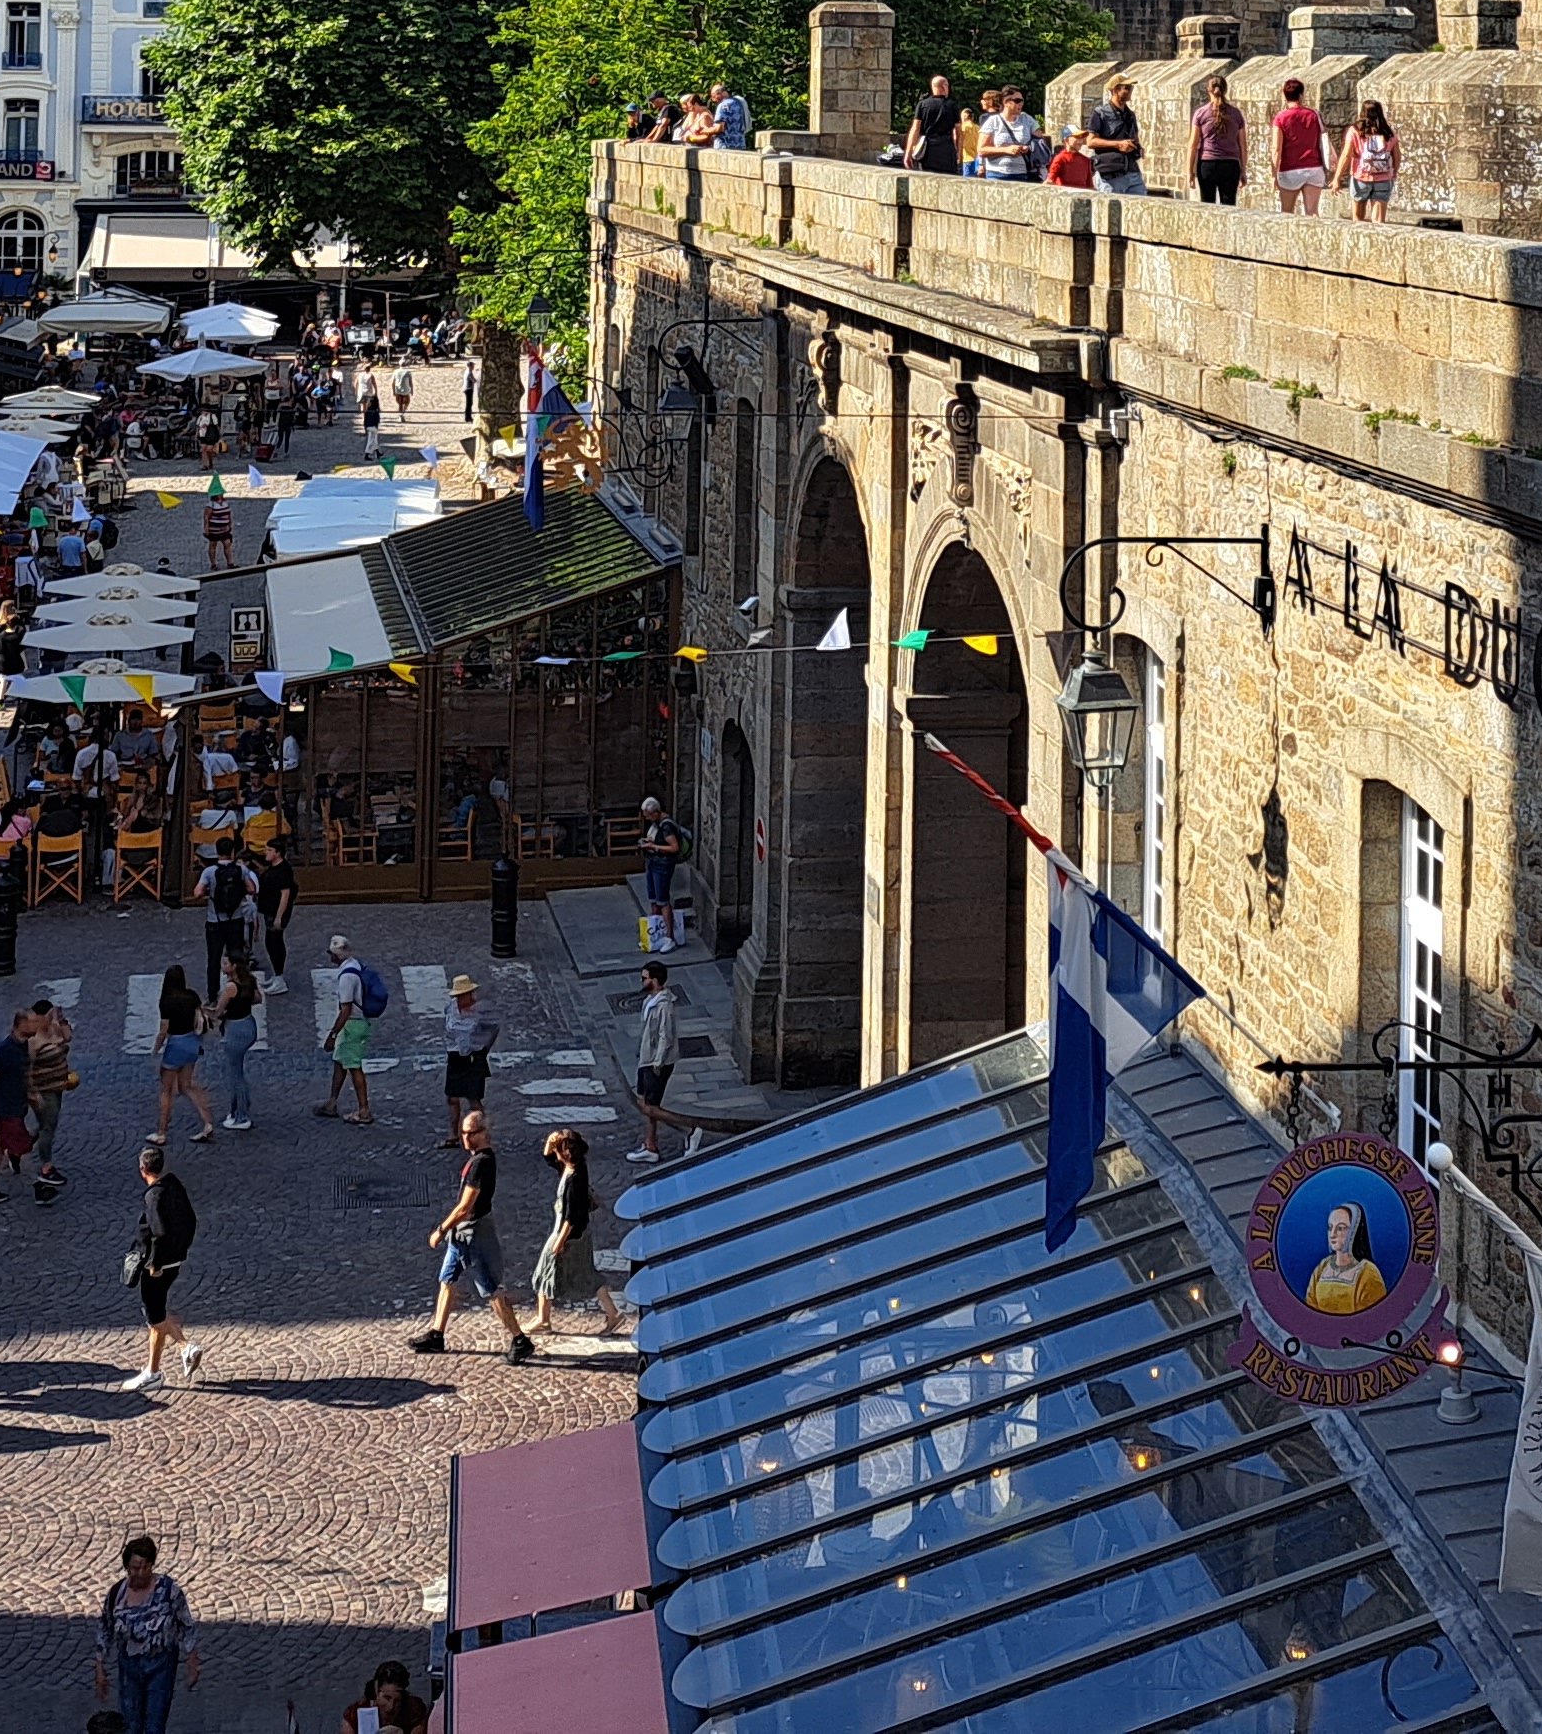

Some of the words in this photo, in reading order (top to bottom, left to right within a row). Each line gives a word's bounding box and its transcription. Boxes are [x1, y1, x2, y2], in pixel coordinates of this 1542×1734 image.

[1282, 522, 1309, 606] A
[1344, 539, 1400, 652] LA
[1269, 1137, 1409, 1198] DUCHESSE
[1251, 1201, 1281, 1243] LA
[1405, 1186, 1436, 1266] ANNE
[1253, 1249, 1275, 1273] A
[1242, 1330, 1437, 1406] RESTAURANT
